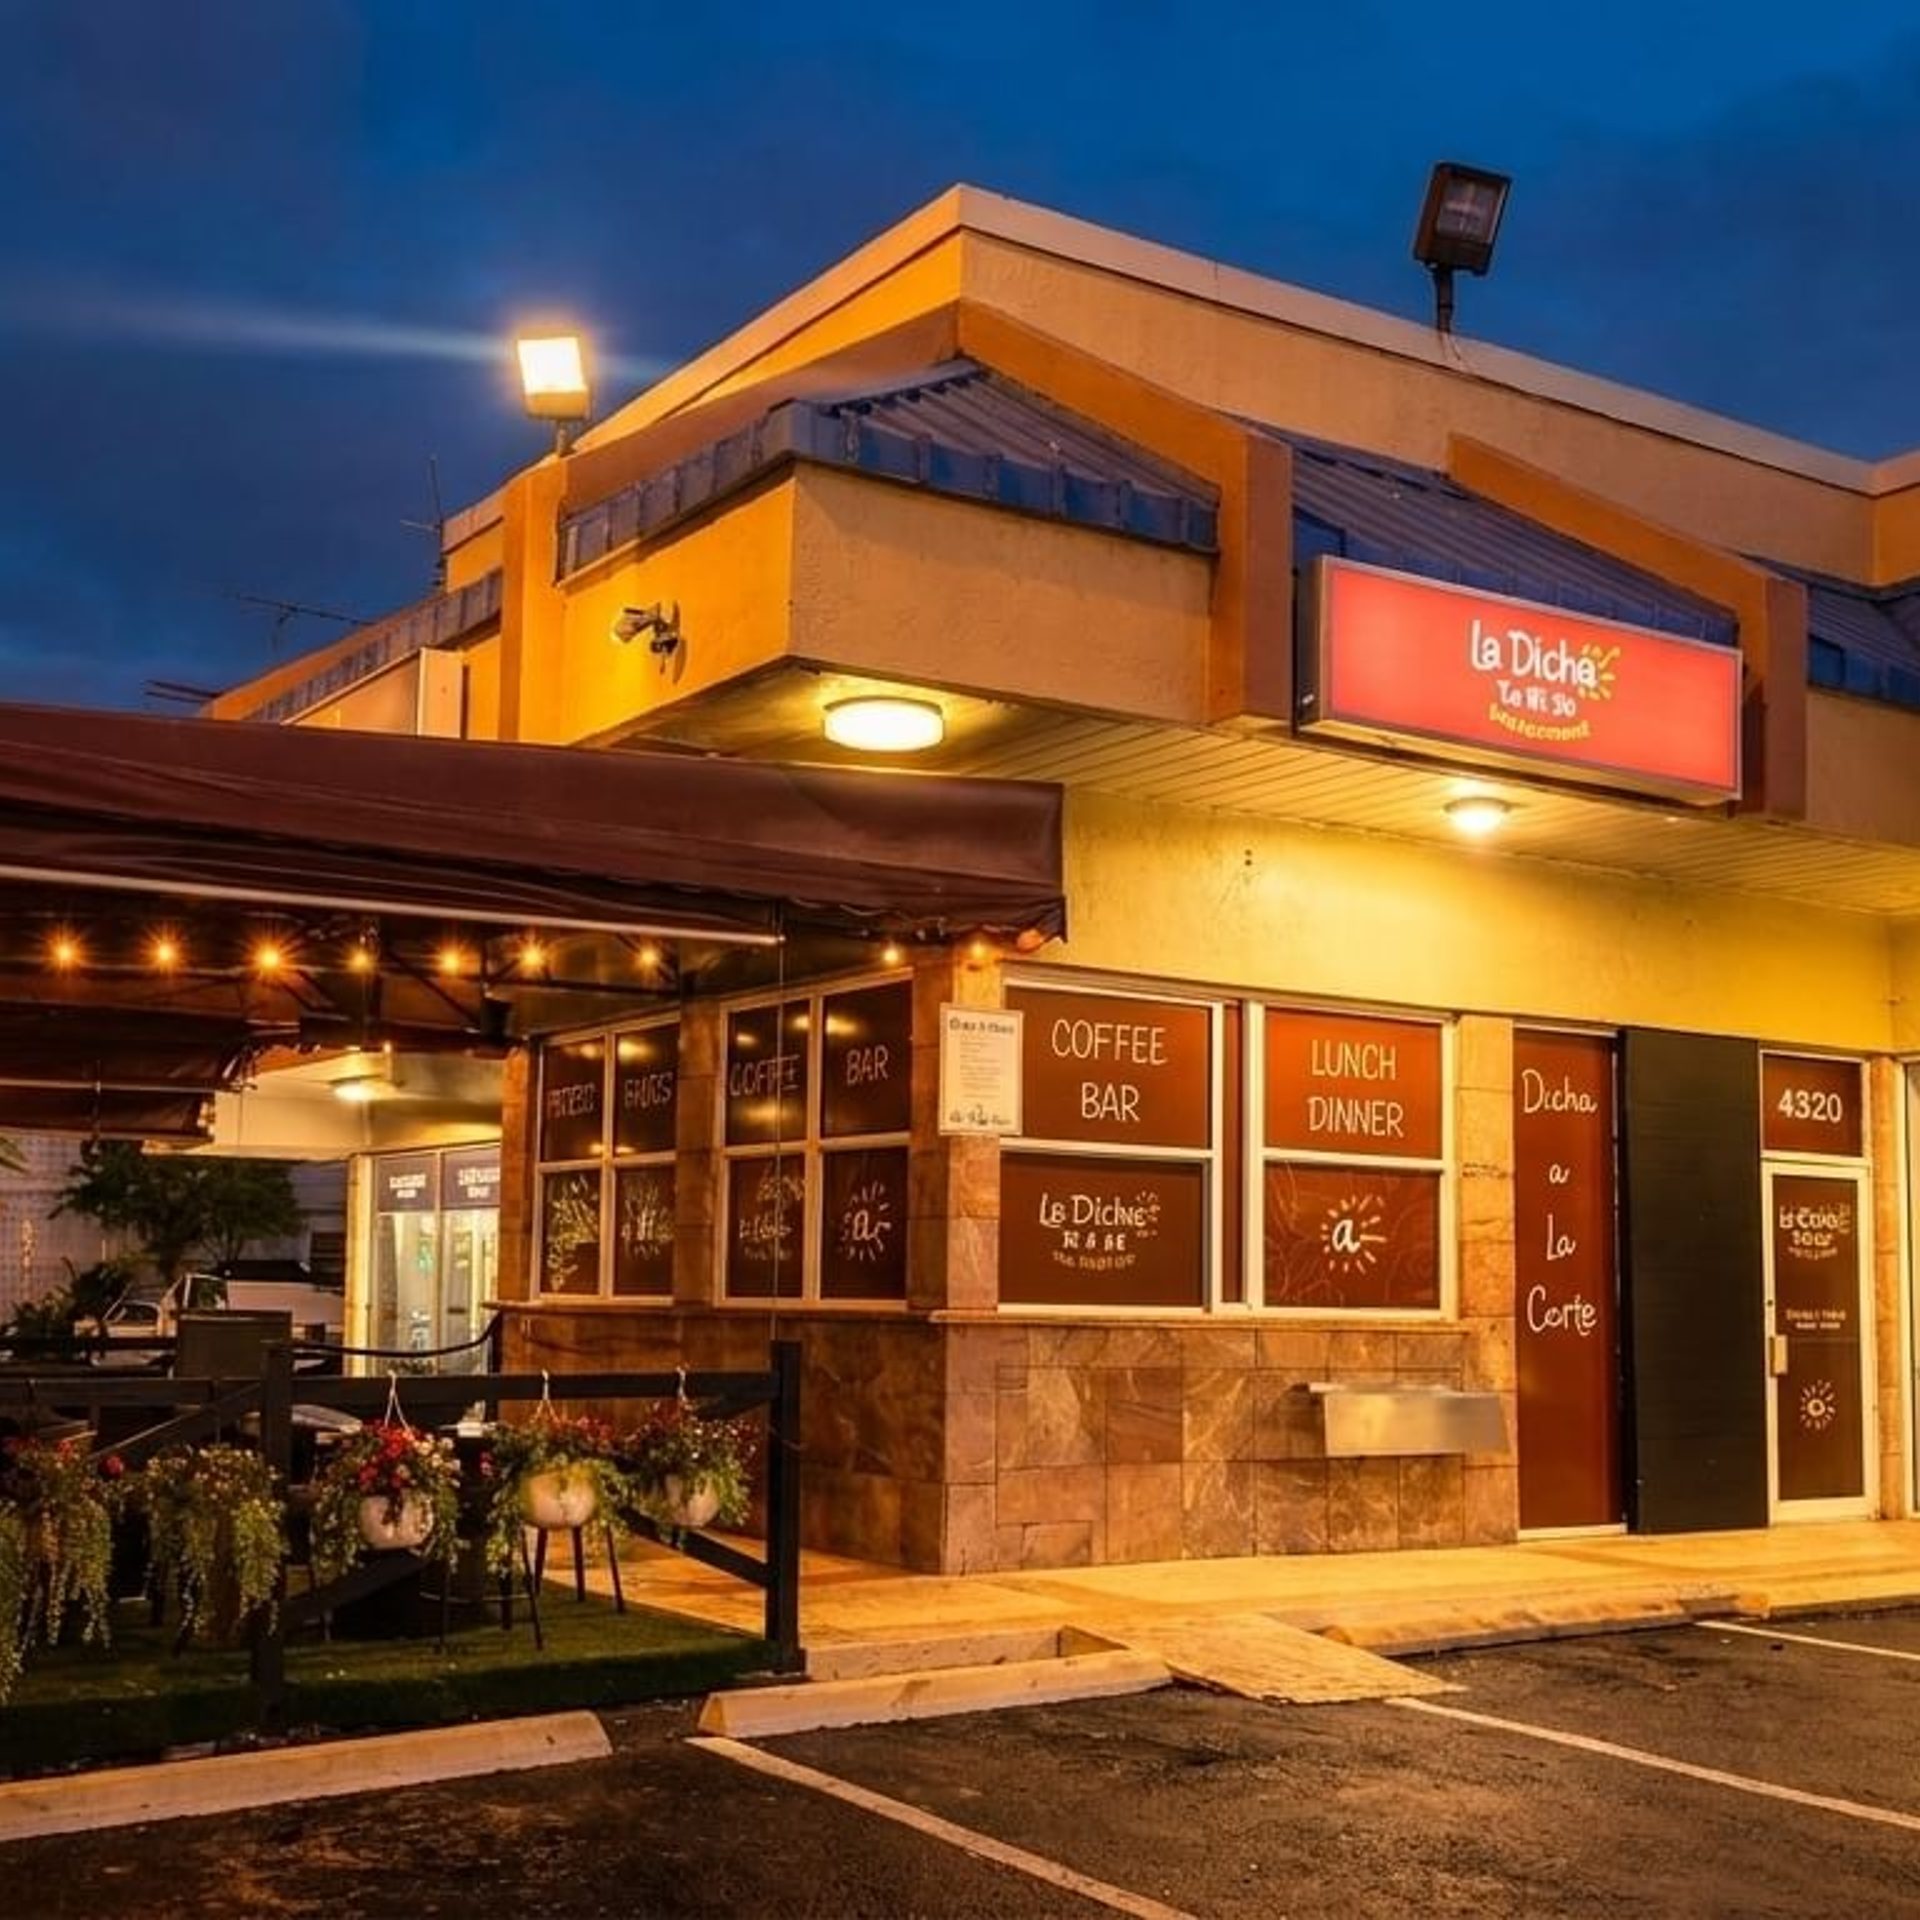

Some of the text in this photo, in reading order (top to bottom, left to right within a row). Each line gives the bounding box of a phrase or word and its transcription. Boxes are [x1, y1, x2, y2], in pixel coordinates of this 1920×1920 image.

[1051, 1018, 1168, 1066] COFFEE
[1311, 1038, 1397, 1081] LUNCH
[846, 1045, 889, 1087] BAR
[1081, 1081, 1140, 1122] BAR
[1308, 1095, 1404, 1138] DINNER
[1778, 1088, 1843, 1122] 4320
